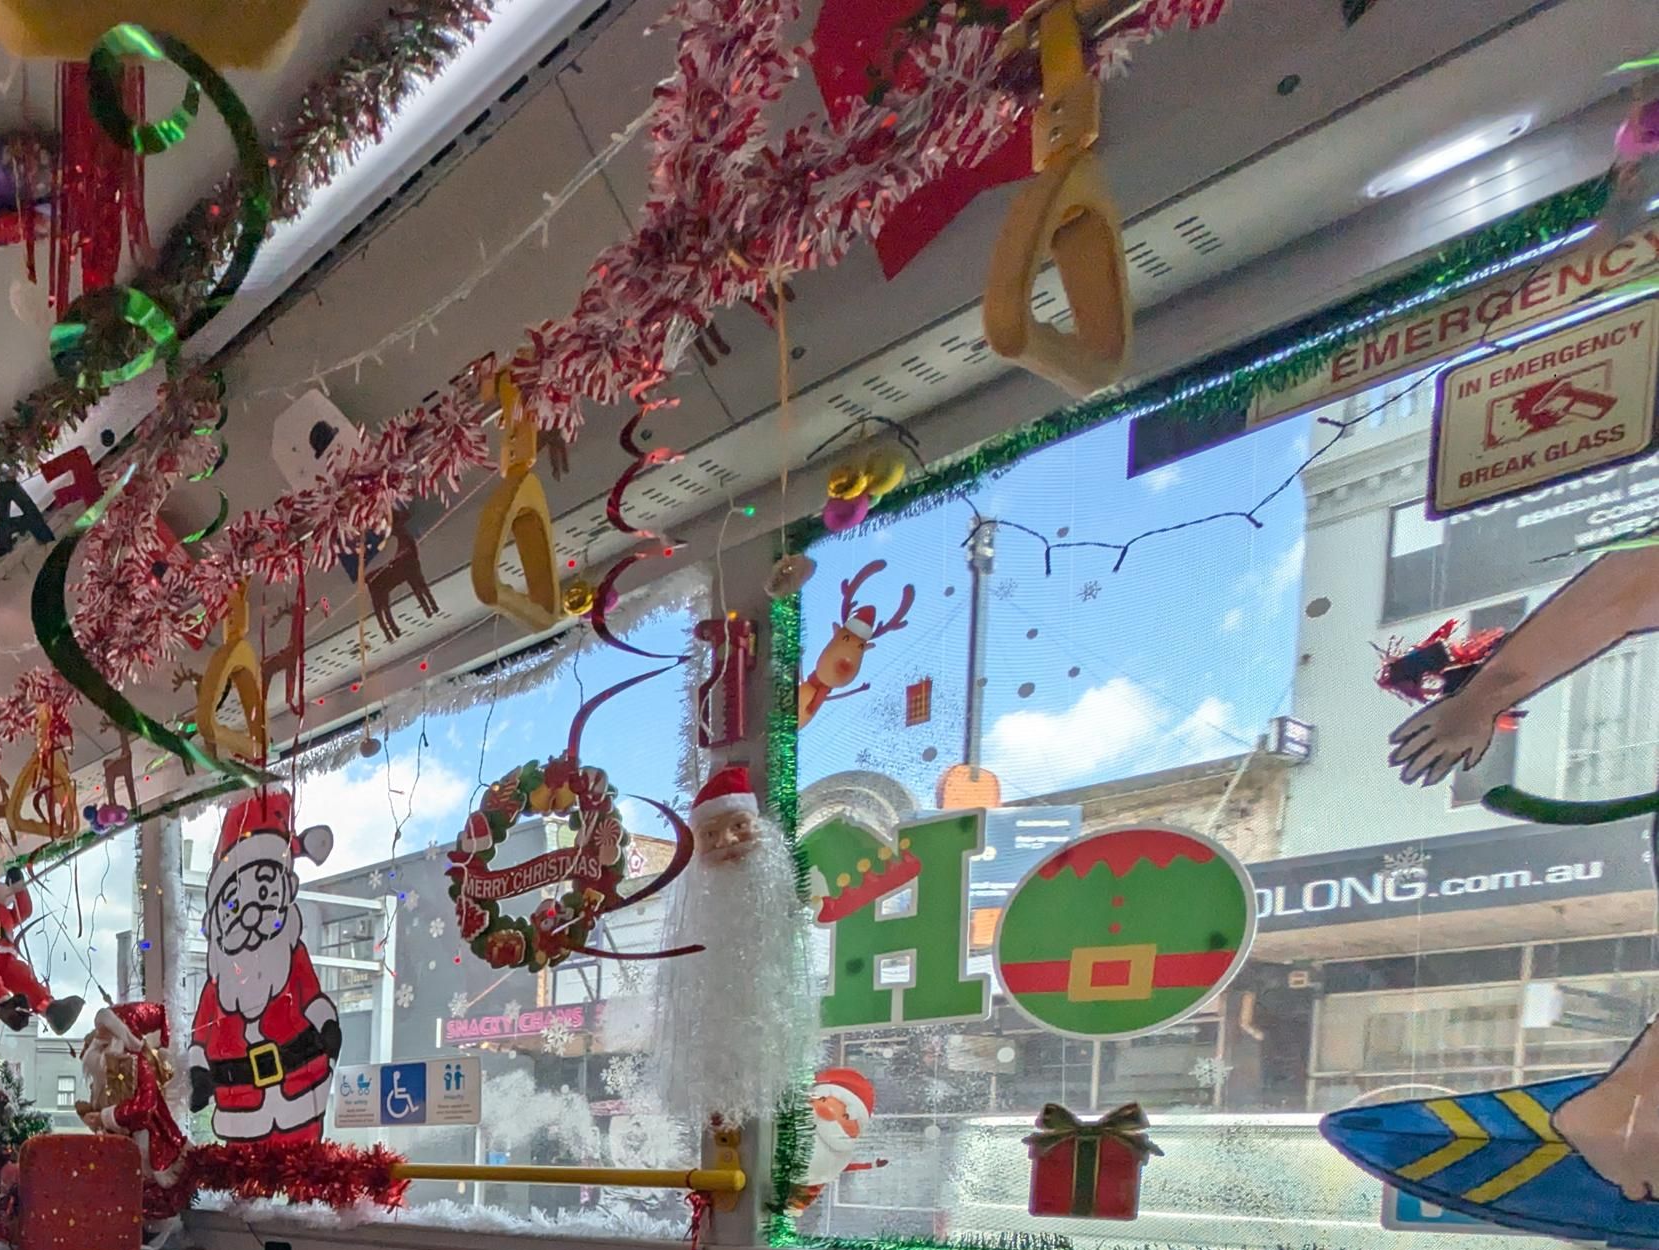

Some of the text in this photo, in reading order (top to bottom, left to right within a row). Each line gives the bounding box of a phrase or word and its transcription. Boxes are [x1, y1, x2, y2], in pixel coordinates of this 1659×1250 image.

[1458, 319, 1645, 400] IN EMERGENCY
[1458, 423, 1626, 490] BREAK GLASS
[465, 855, 598, 898] MERRY CHRISTMAS
[446, 1016, 513, 1039] SNACKY
